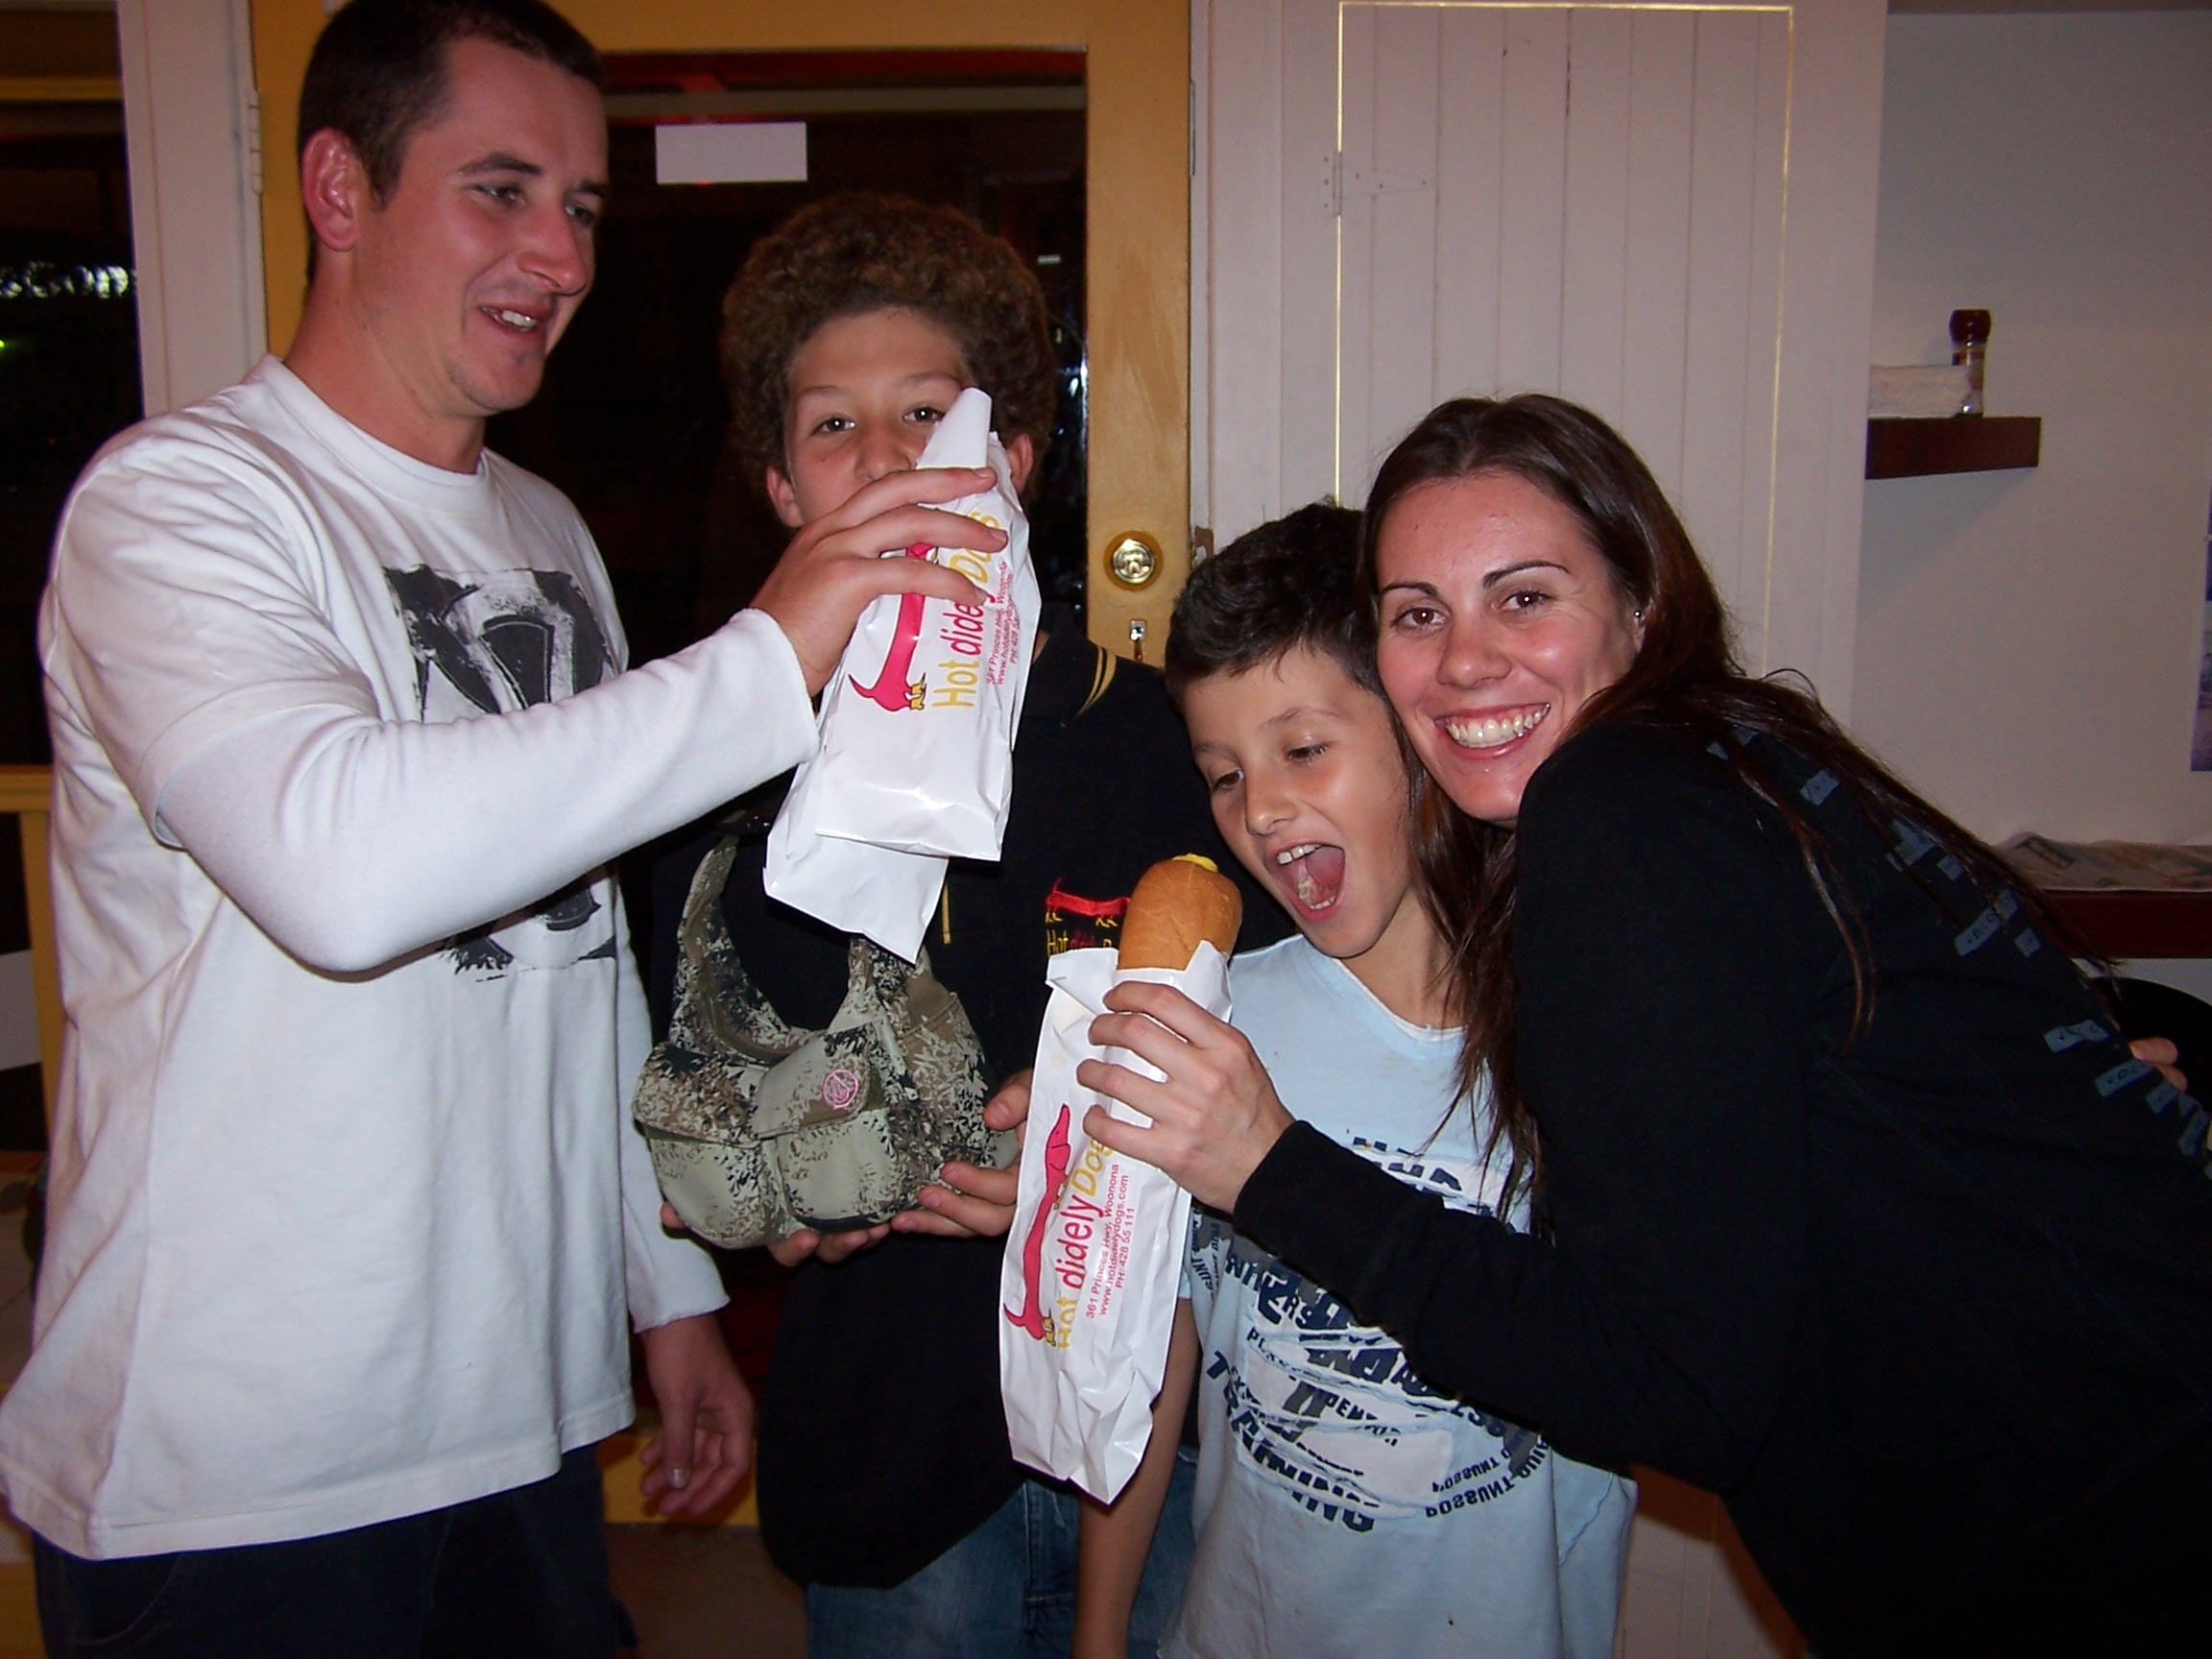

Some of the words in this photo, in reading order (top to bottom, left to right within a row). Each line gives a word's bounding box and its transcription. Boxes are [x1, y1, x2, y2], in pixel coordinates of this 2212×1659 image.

[940, 592, 997, 657] dide
[988, 627, 1002, 666] Princes
[931, 659, 981, 708] Hot
[1103, 1164, 1120, 1218] Woonona
[1101, 1220, 1115, 1249] Hwy,
[1121, 1228, 1132, 1244] 55
[1124, 1206, 1135, 1227] 111
[1055, 1193, 1104, 1290] didely
[1098, 1174, 1130, 1316] www.hotdidelydogs.com
[1118, 1244, 1130, 1267] 428
[1091, 1249, 1109, 1295] Princes
[1115, 1268, 1125, 1289] PH:
[1057, 1295, 1078, 1350] Hot
[1086, 1297, 1098, 1319] 361
